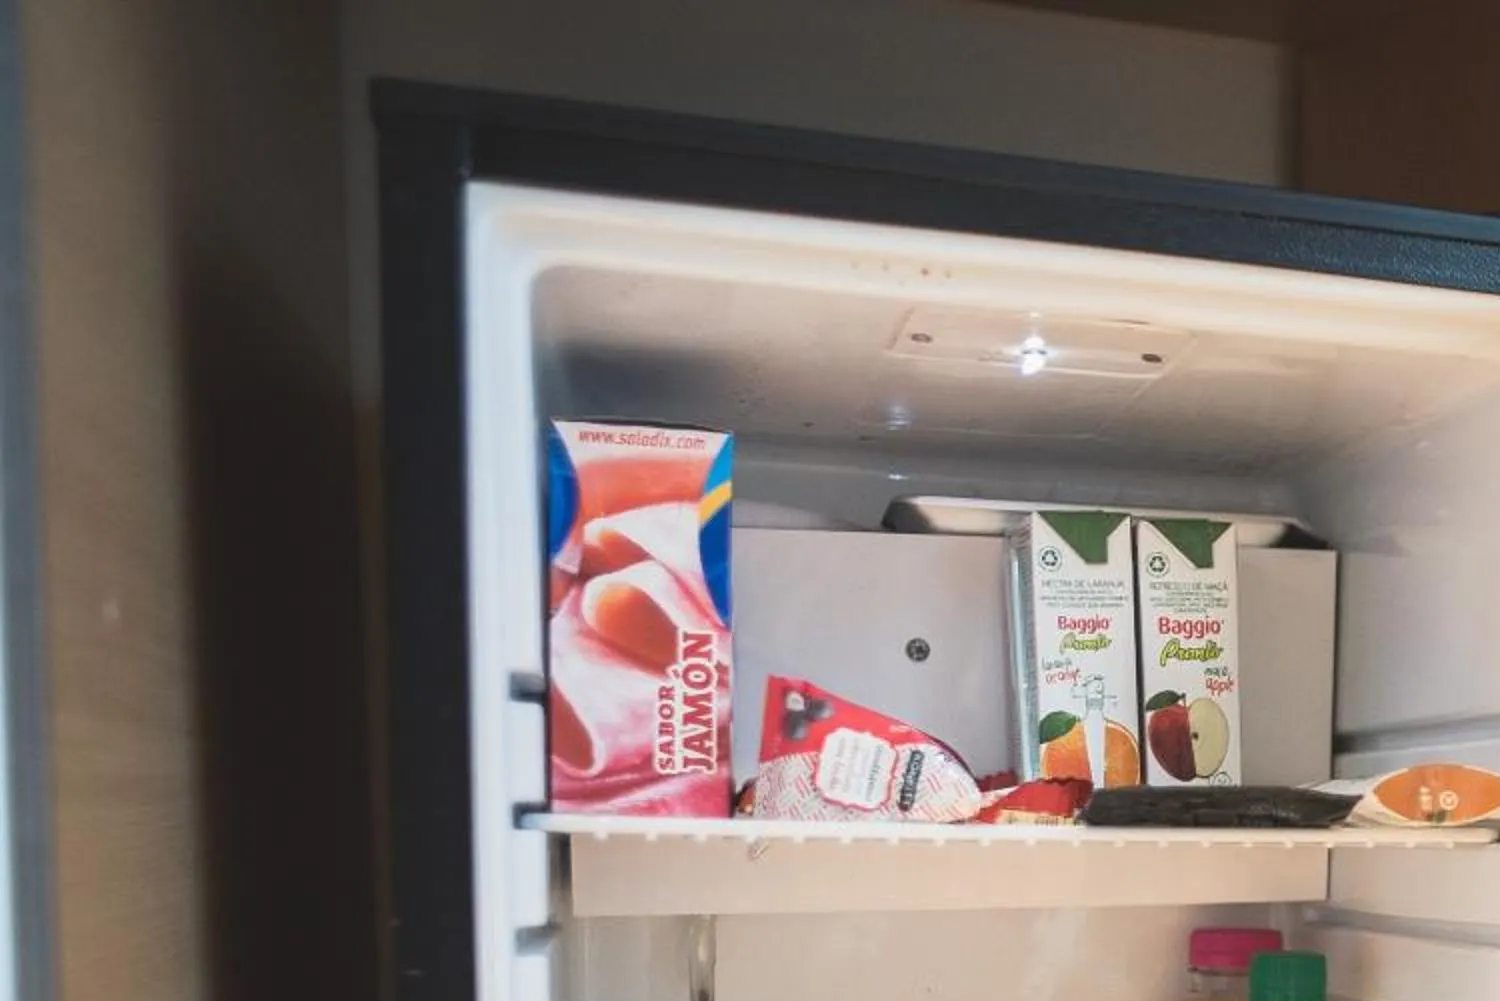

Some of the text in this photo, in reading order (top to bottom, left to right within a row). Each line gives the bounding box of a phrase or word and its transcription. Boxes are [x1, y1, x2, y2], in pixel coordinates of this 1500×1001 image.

[1057, 613, 1110, 635] Baggio
[1158, 615, 1222, 639] Baggio
[658, 684, 676, 771] SABOR
[671, 631, 715, 771] JAMÓN
